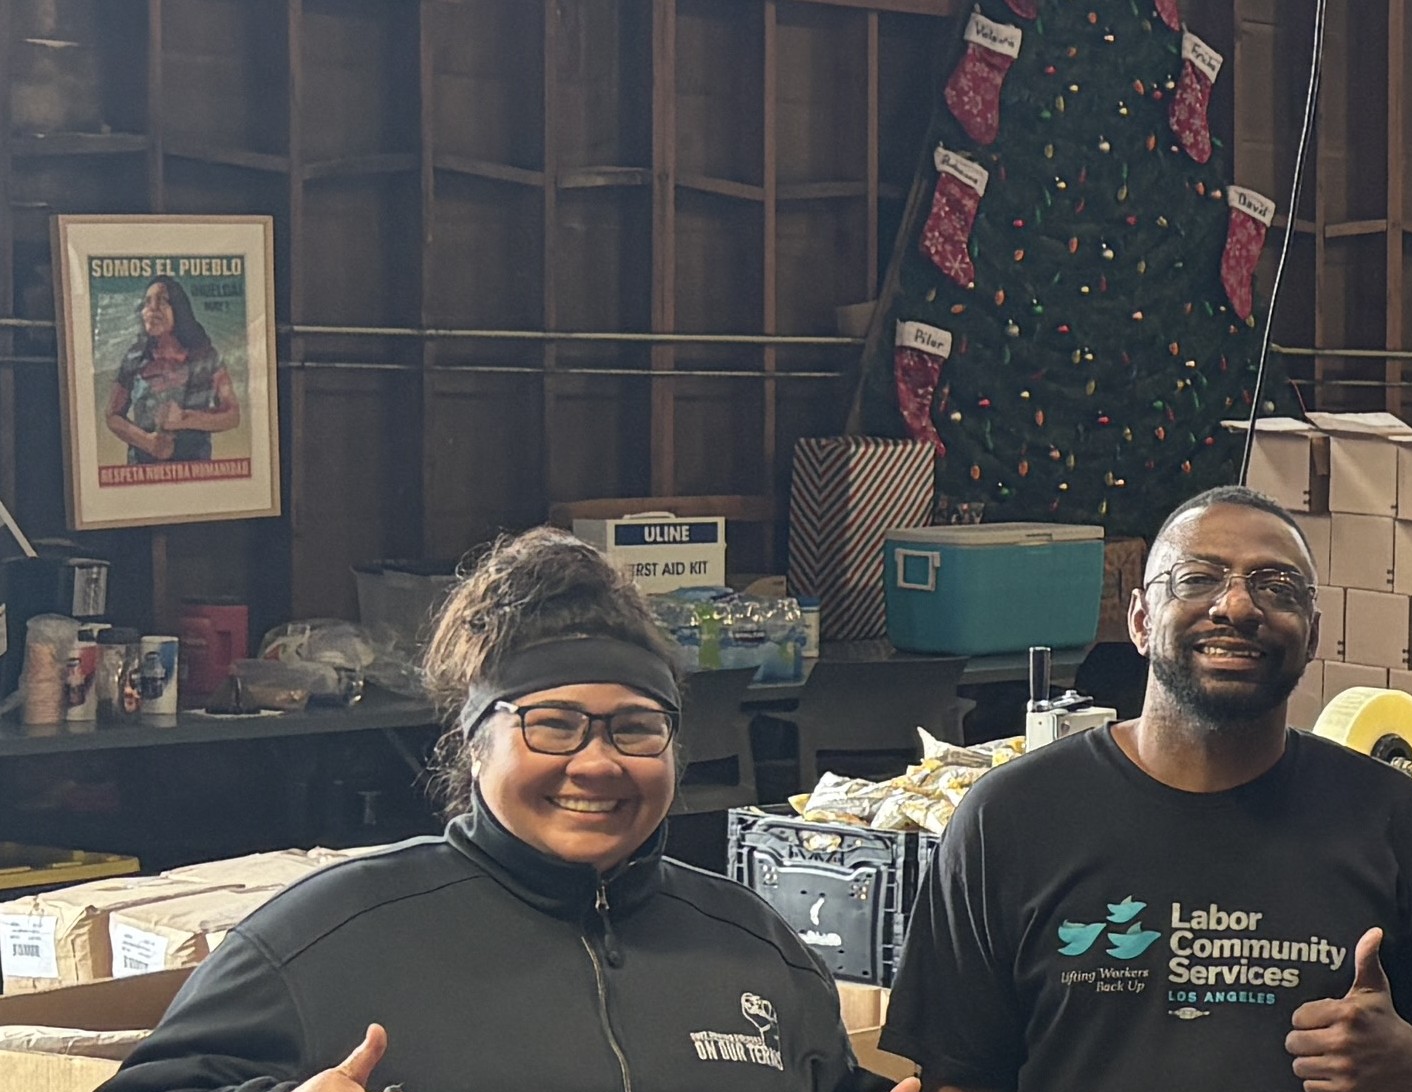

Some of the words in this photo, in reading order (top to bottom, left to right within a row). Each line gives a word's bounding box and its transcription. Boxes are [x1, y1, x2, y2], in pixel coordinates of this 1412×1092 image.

[91, 258, 152, 278] SOMOS
[156, 258, 176, 277] EL
[179, 257, 242, 276] PUEBLO
[101, 466, 145, 483] RESPETA
[145, 463, 190, 481] NUESTRA
[644, 525, 690, 543] ULINE
[627, 562, 659, 577] IRST
[662, 561, 685, 576] AID
[690, 560, 708, 575] KIT
[1171, 902, 1263, 931] Labor
[1169, 930, 1347, 971] Community
[1061, 968, 1096, 985] Lifting
[1100, 966, 1149, 979] Workers
[1168, 957, 1300, 988] Services
[1097, 979, 1124, 992] Back
[1126, 981, 1146, 994] Up
[1168, 990, 1197, 1003] LOS
[1204, 991, 1276, 1005] ANGELES
[694, 1039, 718, 1060] ON
[718, 1040, 748, 1061] OUR
